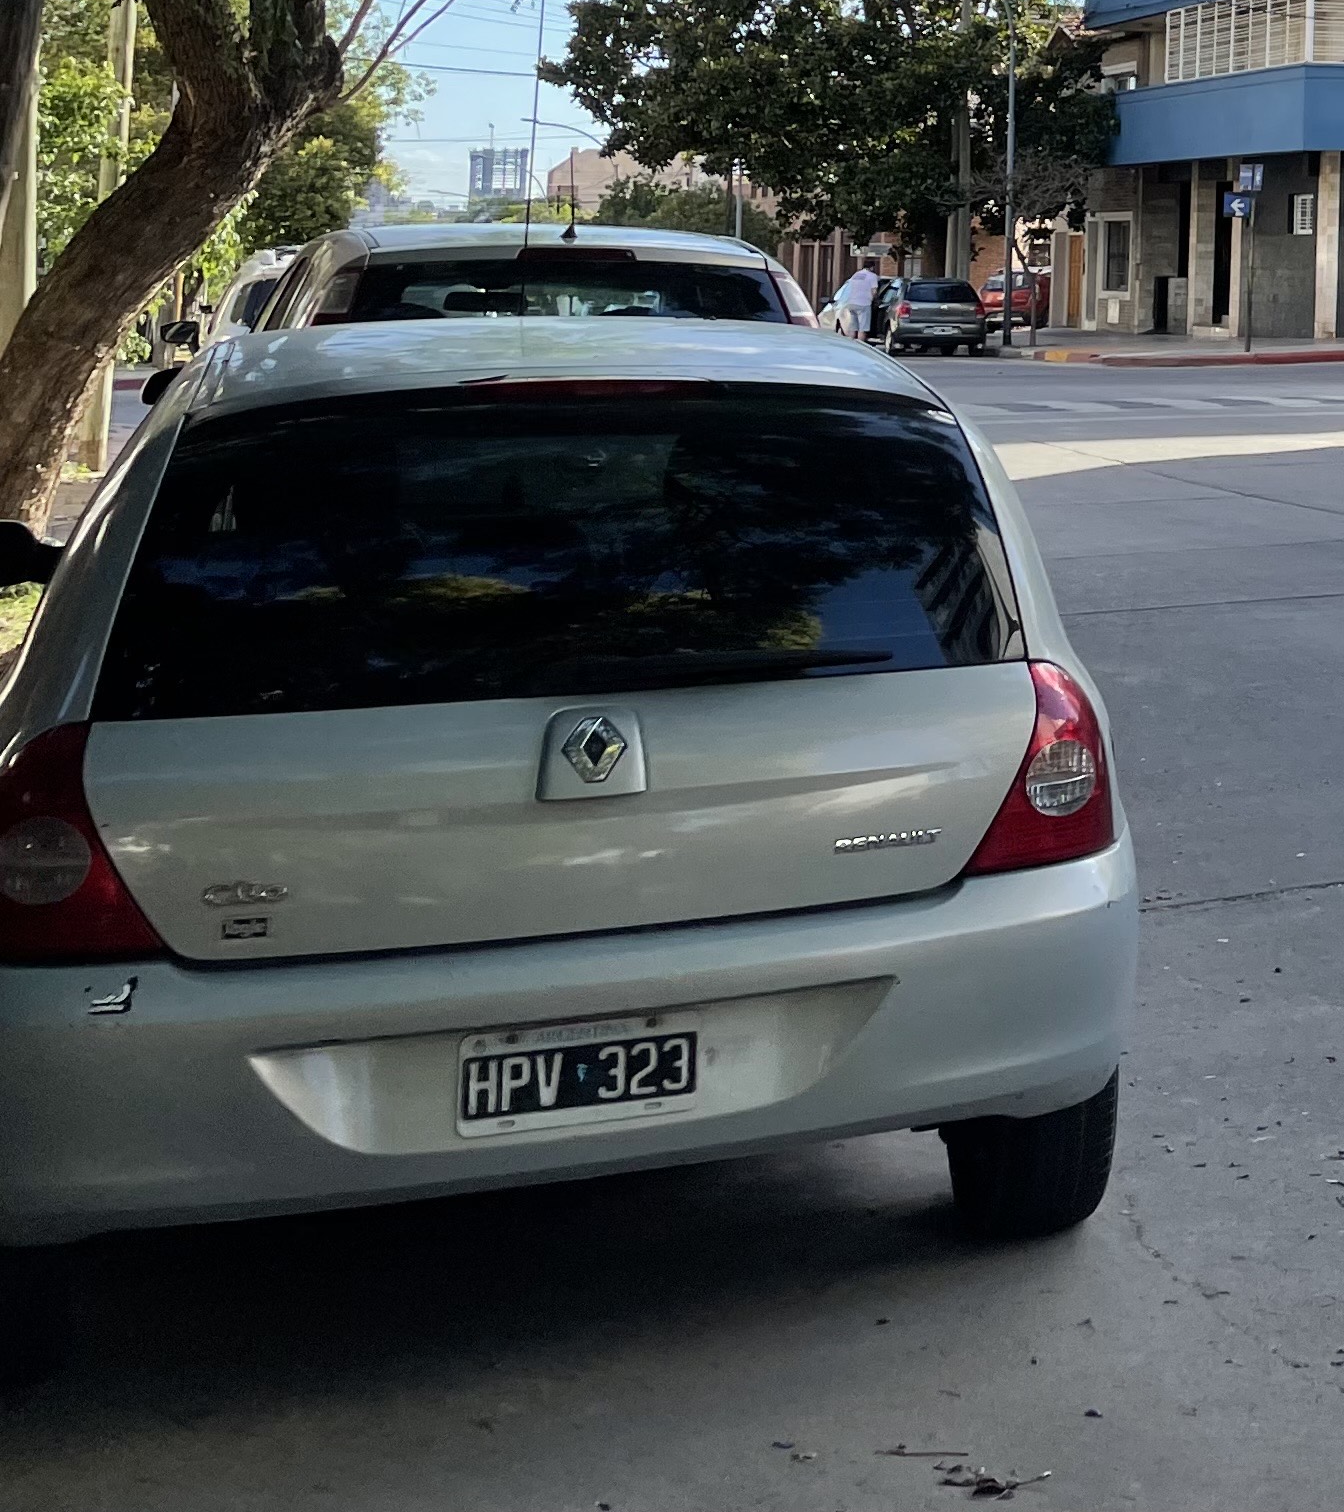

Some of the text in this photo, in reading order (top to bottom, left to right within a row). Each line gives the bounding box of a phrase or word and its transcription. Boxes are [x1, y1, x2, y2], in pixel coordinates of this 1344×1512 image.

[834, 828, 942, 854] RENAULT
[468, 1038, 689, 1115] HPV 323
